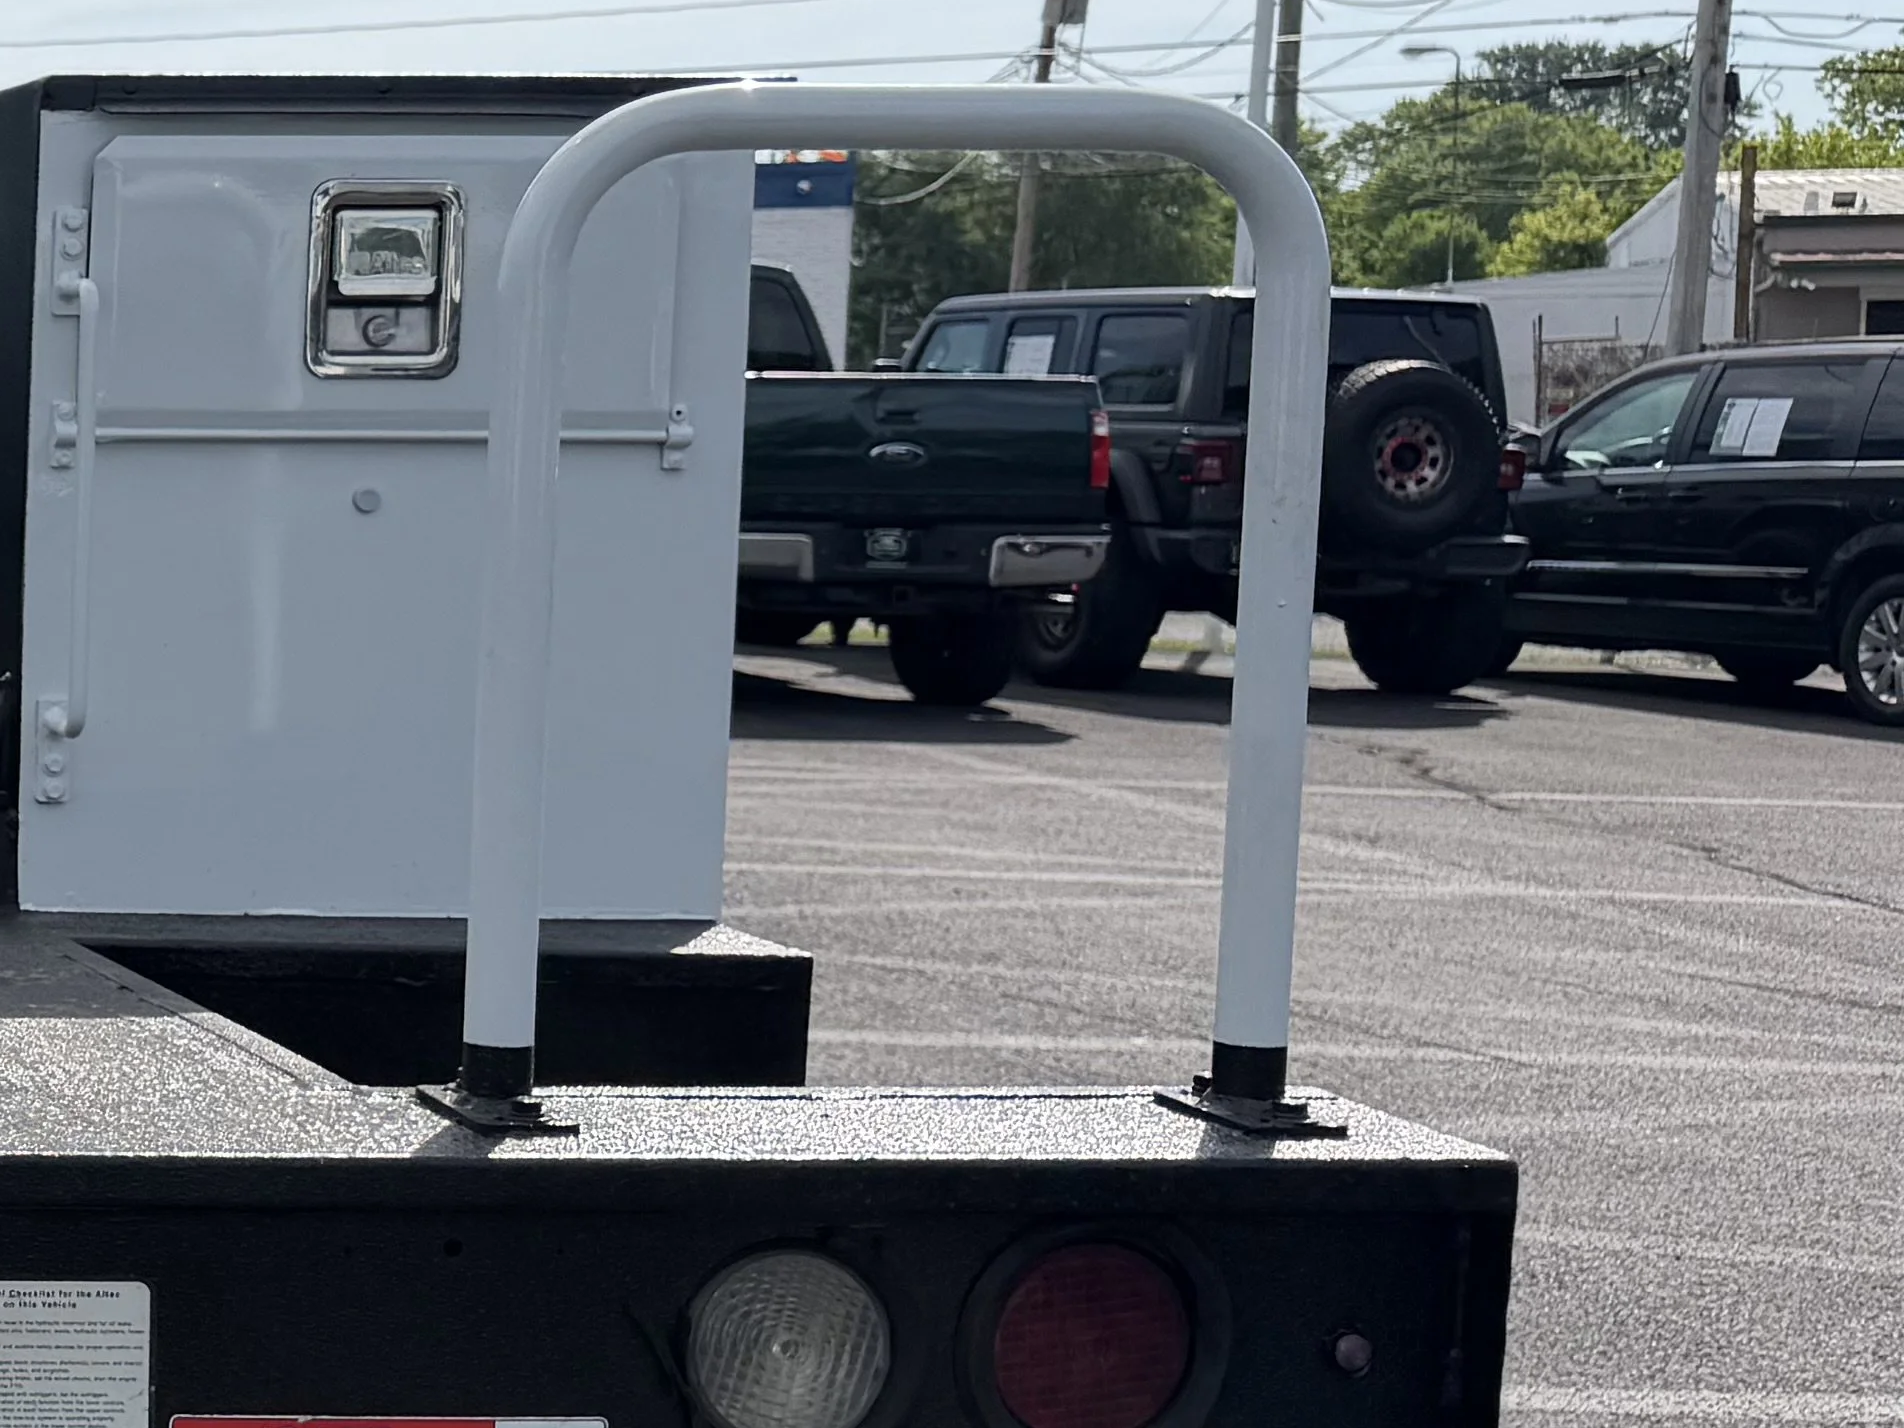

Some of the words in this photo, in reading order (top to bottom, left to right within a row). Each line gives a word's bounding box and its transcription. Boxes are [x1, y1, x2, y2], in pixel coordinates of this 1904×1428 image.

[58, 1289, 72, 1299] for
[76, 1289, 92, 1299] the
[95, 1289, 121, 1299] Altec
[2, 1301, 16, 1309] on
[40, 1300, 77, 1309] Vehicle
